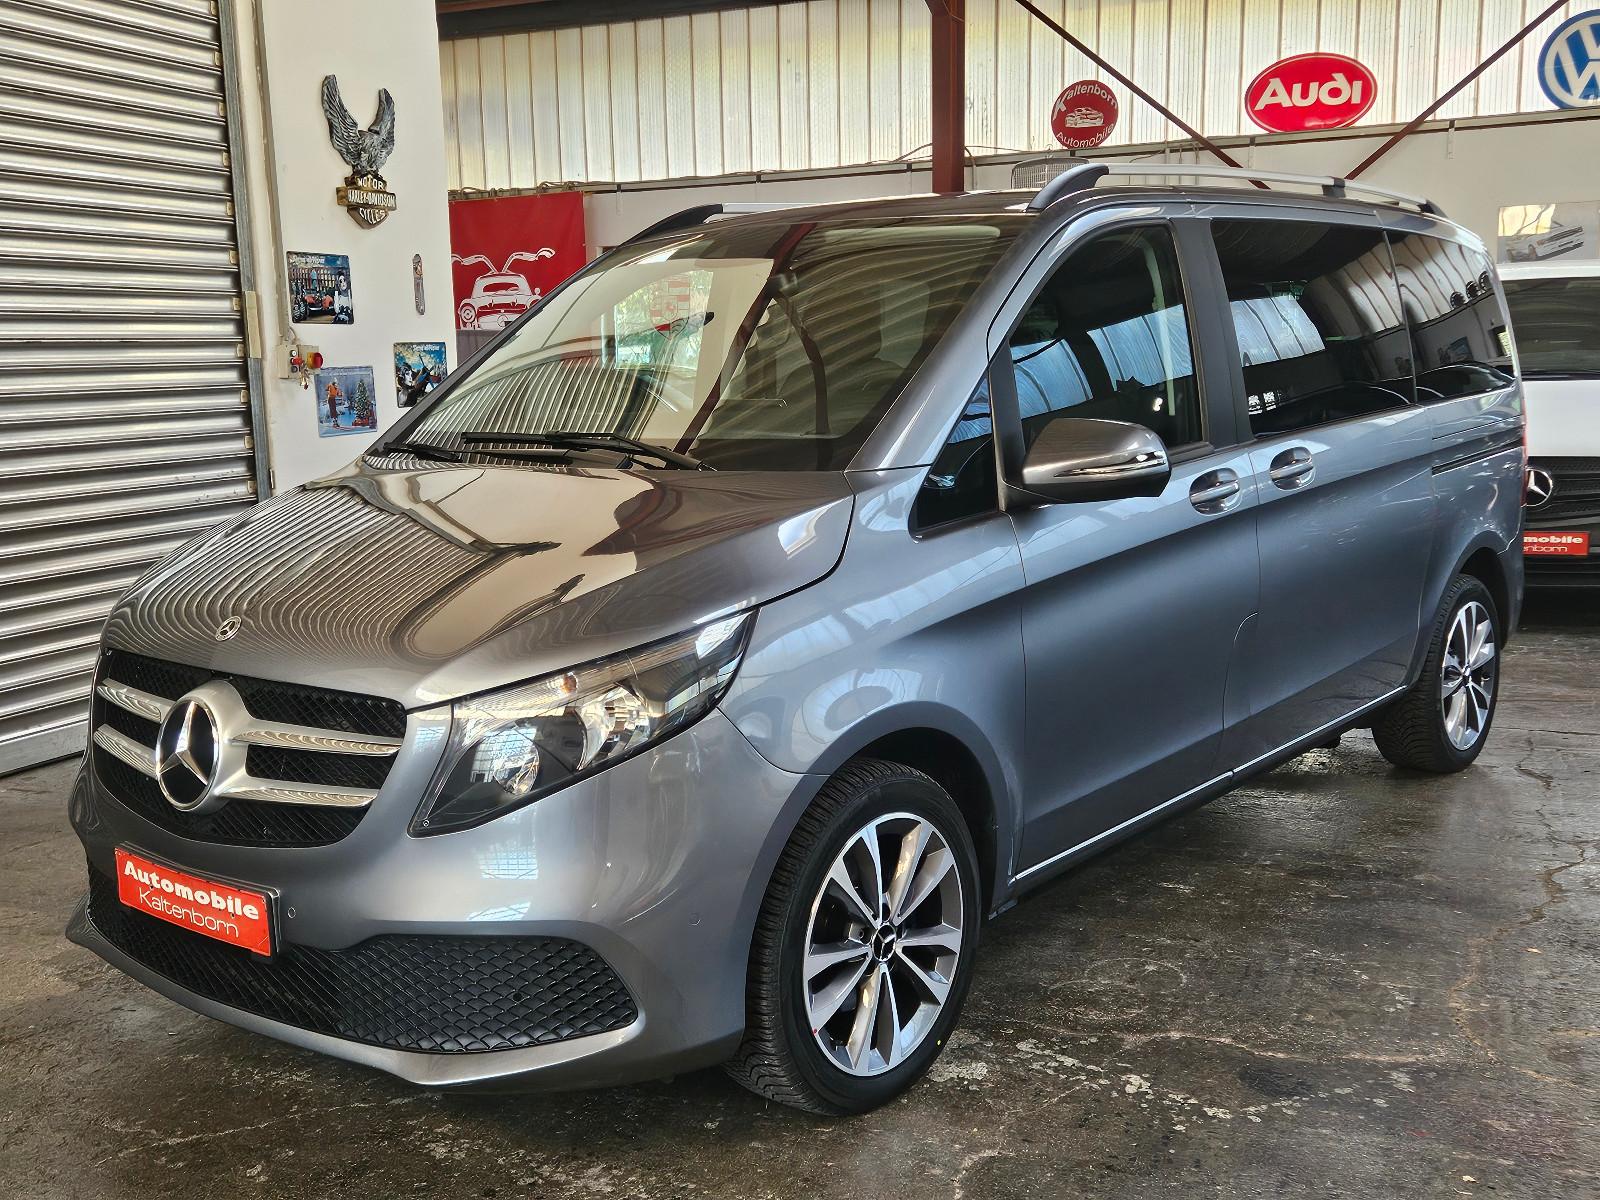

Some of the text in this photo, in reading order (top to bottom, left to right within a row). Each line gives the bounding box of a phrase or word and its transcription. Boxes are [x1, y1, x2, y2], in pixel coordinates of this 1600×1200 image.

[1053, 84, 1118, 121] Kaltenborn
[1056, 123, 1114, 148] Automobile
[359, 207, 387, 225] CYCLES
[124, 861, 259, 920] Automobile
[139, 887, 239, 938] Kaltenborn
